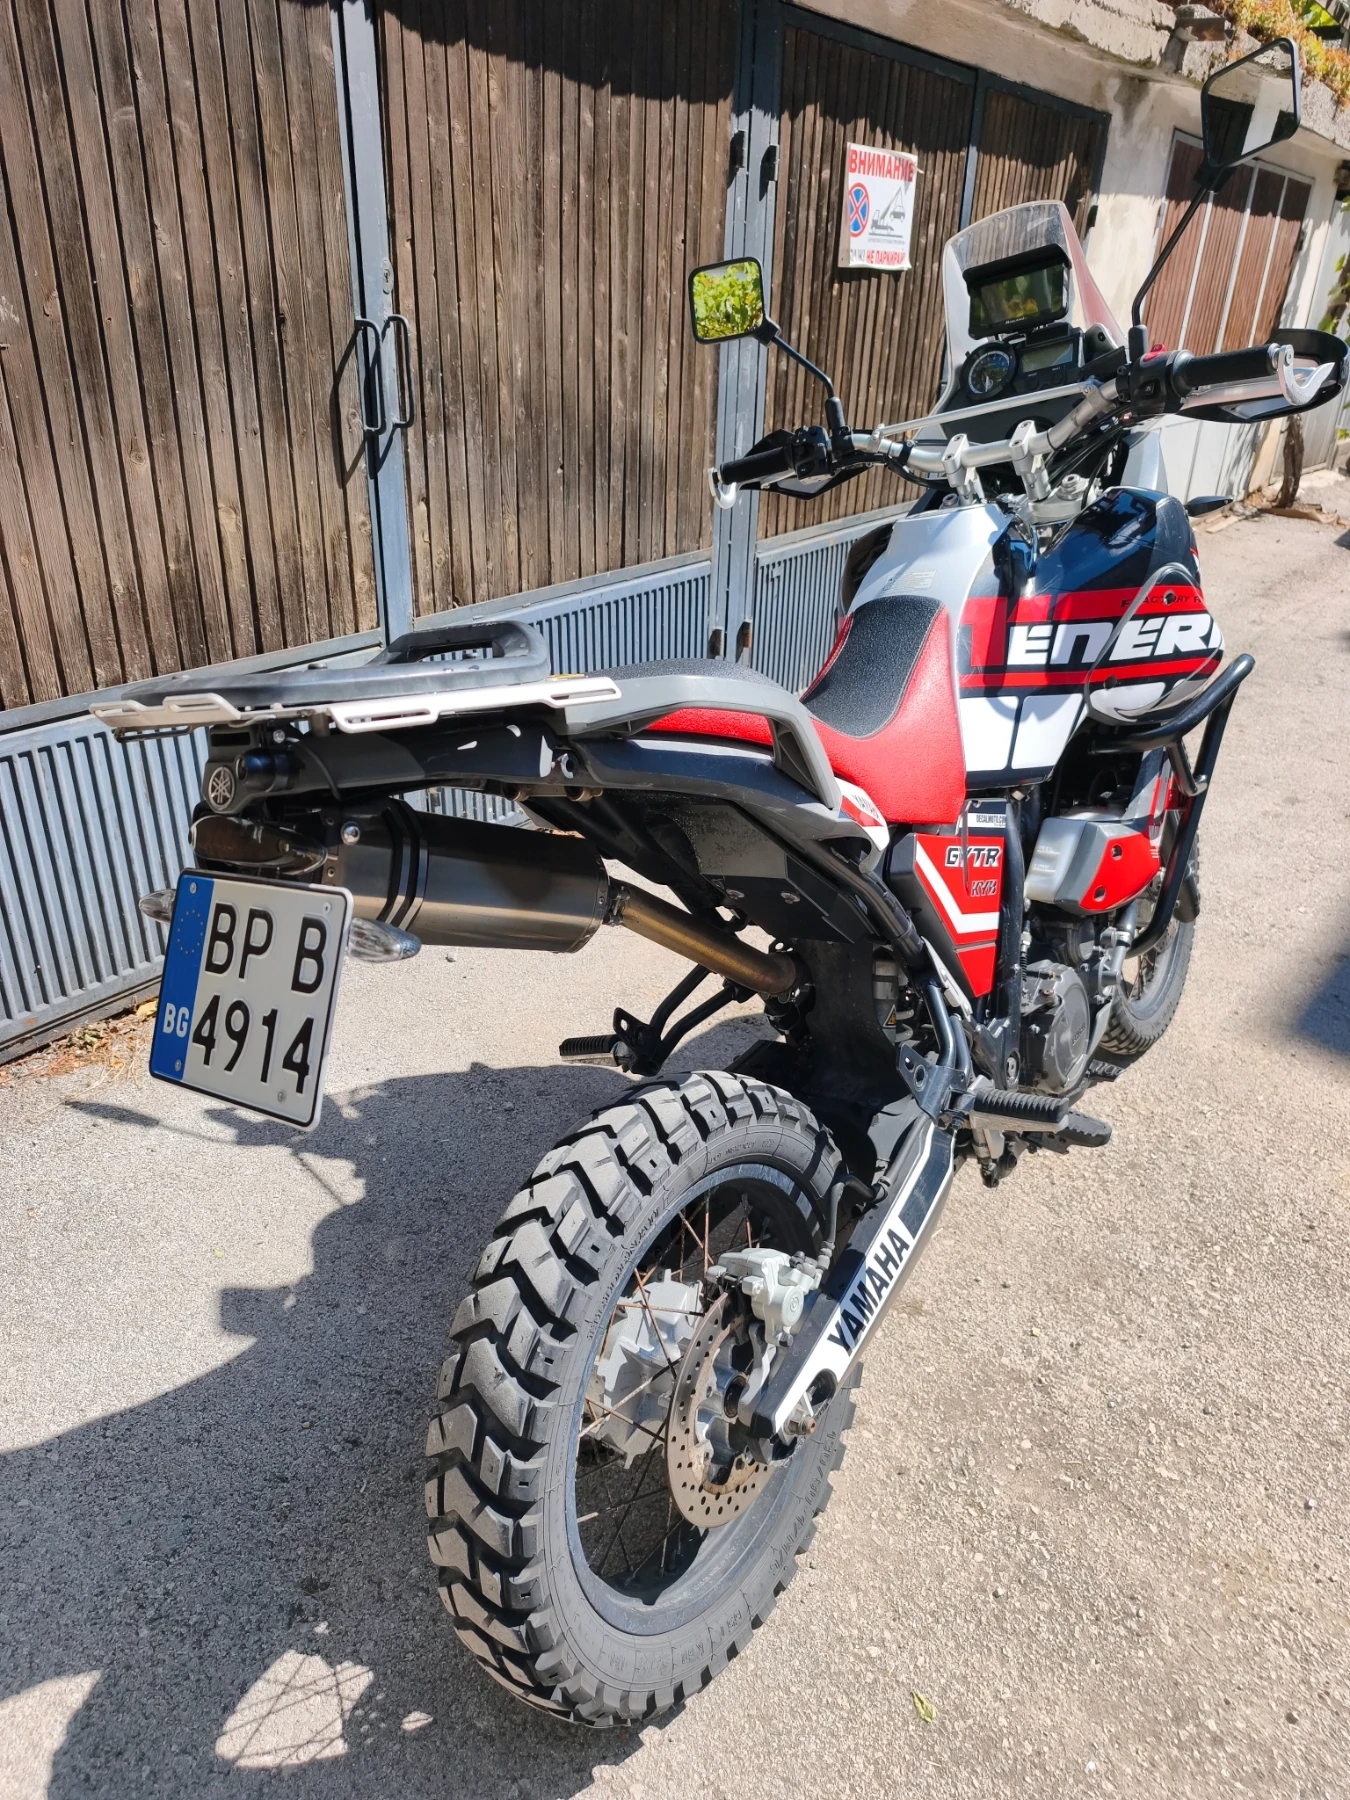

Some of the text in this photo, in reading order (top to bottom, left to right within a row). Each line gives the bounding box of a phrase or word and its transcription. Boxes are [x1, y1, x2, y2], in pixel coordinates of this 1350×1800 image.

[848, 149, 914, 183] ВНИМАНИЕ
[866, 249, 874, 264] НЕ
[944, 845, 1002, 868] GYTR
[205, 902, 327, 995] BP B
[162, 1002, 190, 1038] BG
[192, 994, 315, 1095] 4914
[826, 1227, 911, 1358] YAMAHA
